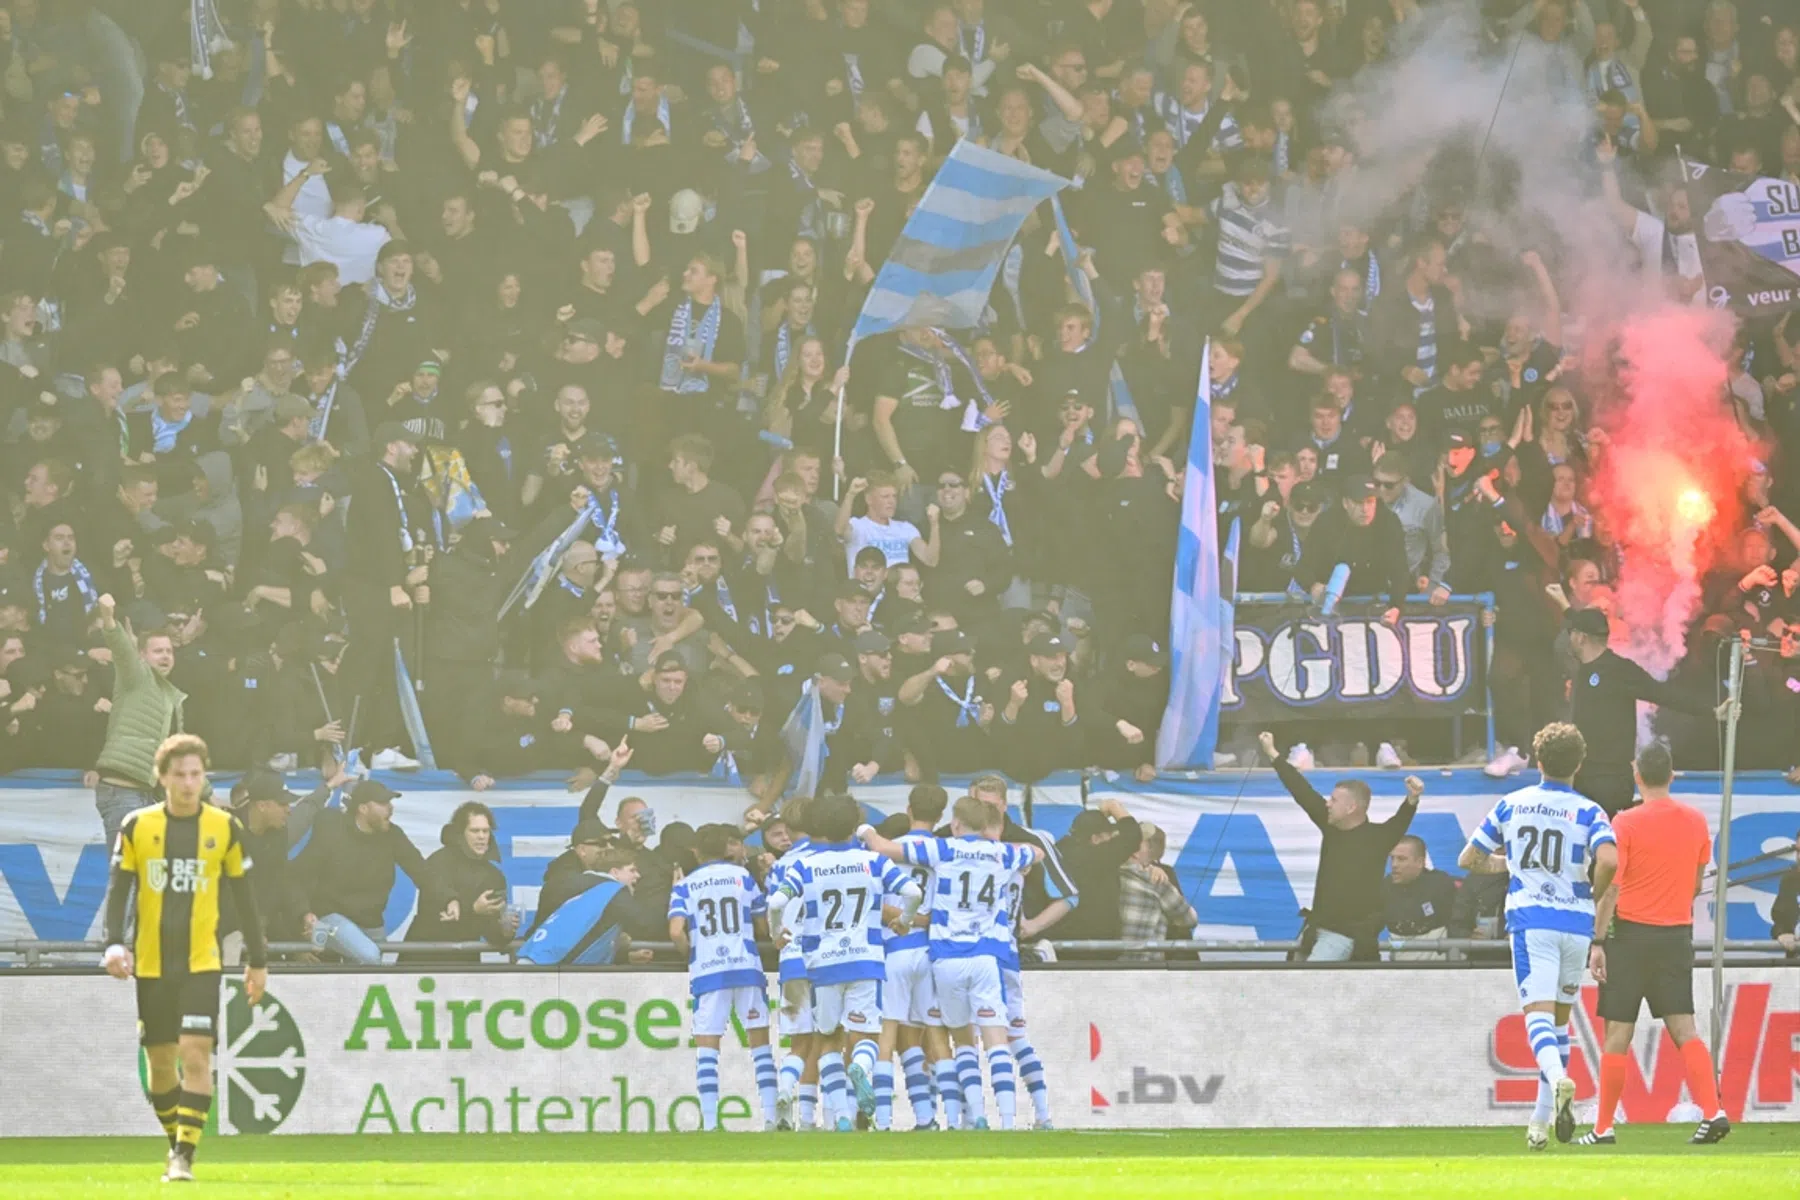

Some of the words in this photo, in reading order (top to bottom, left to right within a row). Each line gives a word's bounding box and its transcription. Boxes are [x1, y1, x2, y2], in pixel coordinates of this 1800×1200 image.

[1747, 289, 1791, 306] veur
[1220, 617, 1472, 704] PGDU
[172, 858, 206, 875] BET
[814, 862, 870, 877] flexfamily
[1517, 825, 1564, 874] 20
[171, 876, 209, 892] CITY
[690, 876, 742, 892] flexfamily
[957, 870, 995, 912] 14
[697, 896, 741, 938] 30
[822, 887, 867, 931] 27
[344, 977, 770, 1050] Aircose
[356, 1077, 752, 1132] Achterhoe
